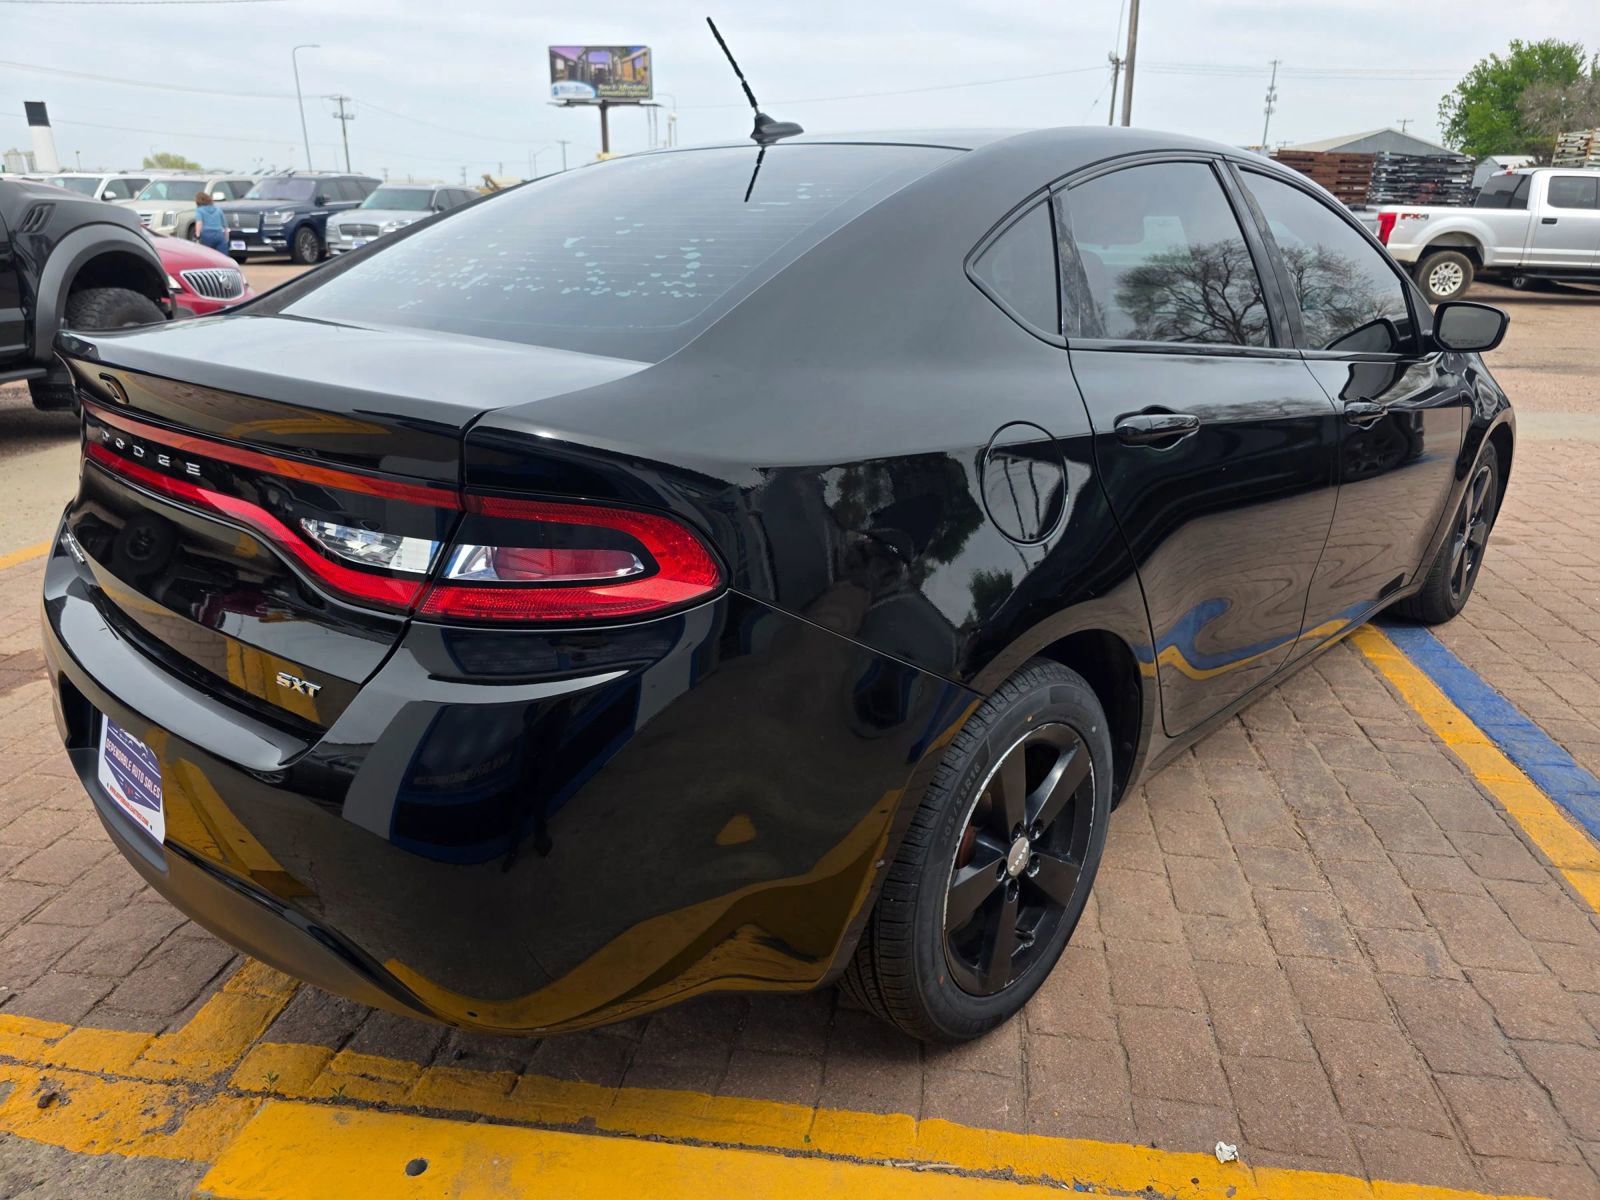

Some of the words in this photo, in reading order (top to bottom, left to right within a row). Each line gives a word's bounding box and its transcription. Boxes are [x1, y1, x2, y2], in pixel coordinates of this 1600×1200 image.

[1401, 213, 1429, 221] FX4
[101, 430, 201, 476] DODGE
[275, 671, 322, 698] SXT
[105, 738, 132, 772] DEPENDABLE
[131, 763, 145, 783] AUTO
[143, 774, 161, 798] SALES
